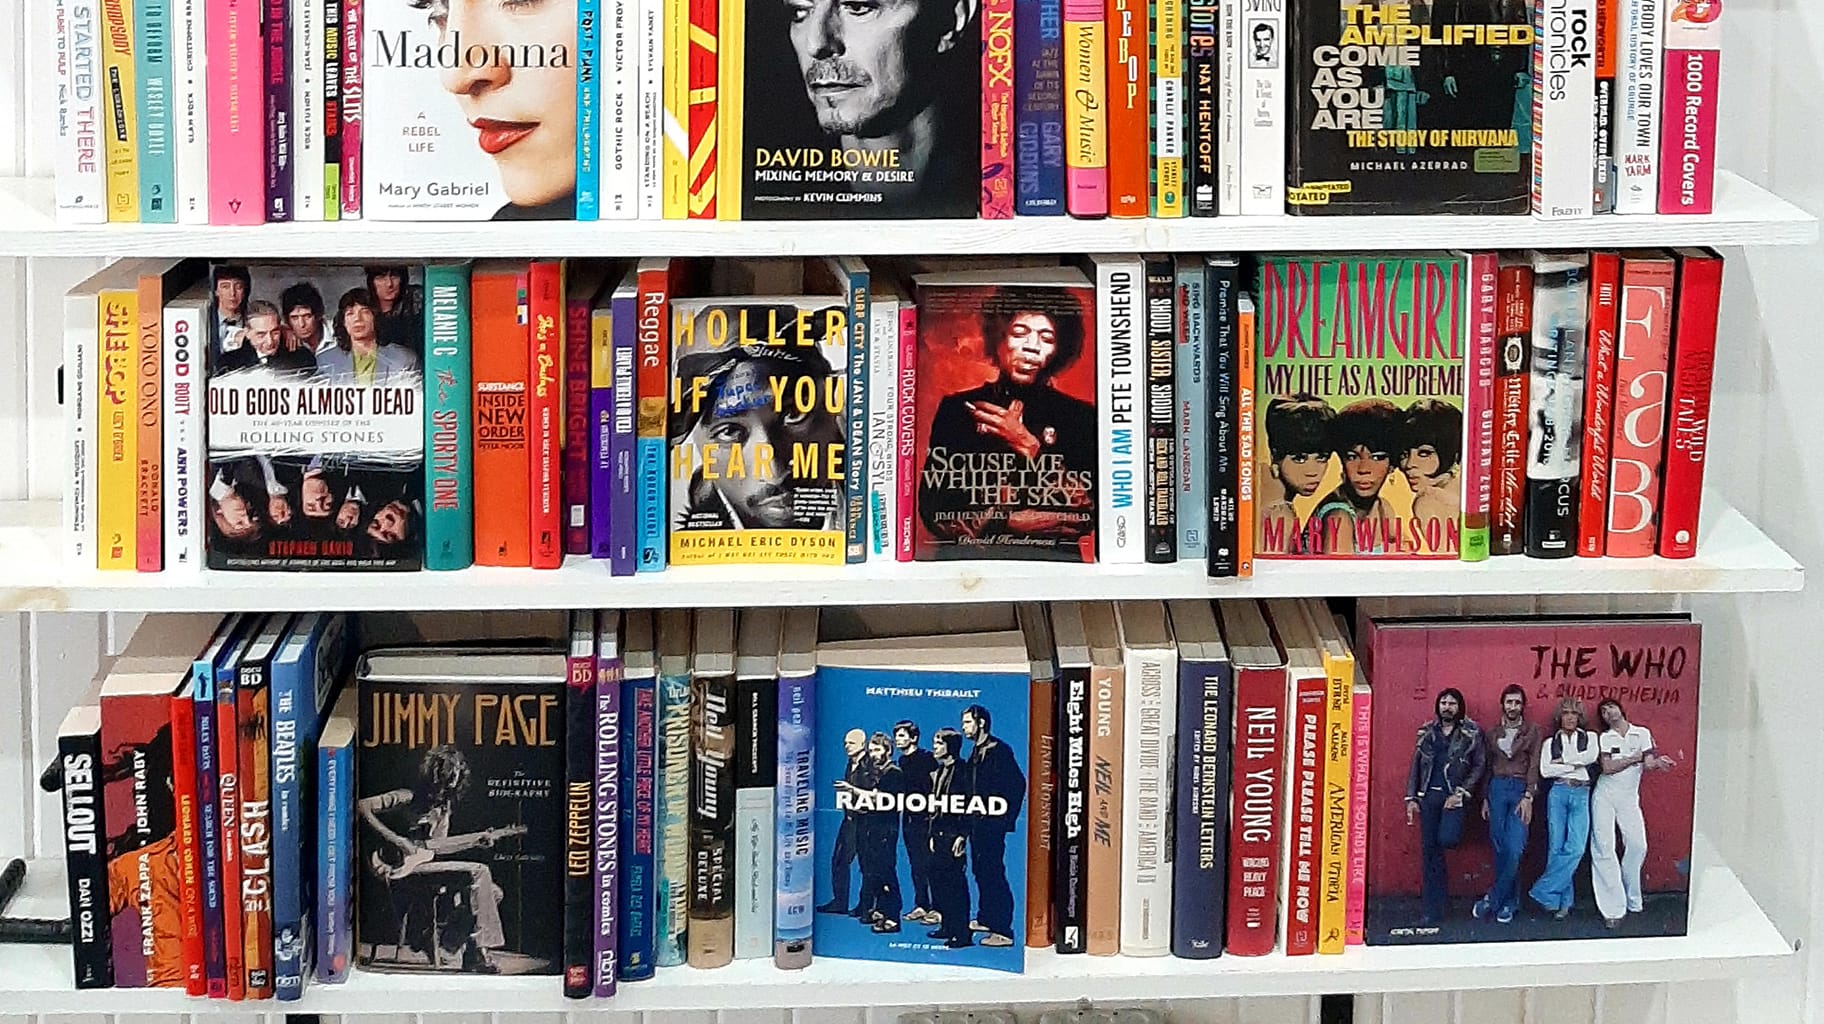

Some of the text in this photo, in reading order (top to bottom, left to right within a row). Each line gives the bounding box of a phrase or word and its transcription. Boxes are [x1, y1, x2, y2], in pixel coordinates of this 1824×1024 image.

[1342, 5, 1411, 24] THE
[371, 30, 572, 68] Madonna
[989, 10, 1012, 88] NOFX
[1340, 25, 1535, 45] AMPLIFIED
[1572, 9, 1590, 68] rock
[1312, 46, 1420, 66] COME
[1640, 44, 1653, 79] LOVES
[1312, 67, 1362, 88] AS
[615, 93, 623, 125] ROCK
[1312, 88, 1384, 108] YOU
[1639, 82, 1650, 106] OUR
[402, 126, 440, 136] REBEL
[1199, 64, 1211, 174] NAT HENTOFF
[1311, 109, 1383, 129] ARE
[1637, 109, 1650, 147] TOWN
[1682, 54, 1703, 206] 1000 Record Covers
[409, 142, 434, 152] LIFE
[615, 128, 623, 170] GOTHIC
[1347, 129, 1518, 147] THE STORY OF NIRVANA
[756, 149, 900, 167] DAVID BOWIE
[1351, 161, 1467, 170] MICHAEL AZERRAD
[1625, 155, 1650, 164] MARK
[1625, 165, 1650, 176] YARM
[379, 182, 488, 198] Mary Gabriel
[756, 171, 802, 181] MIXING
[805, 171, 858, 182] MEMORY
[876, 171, 914, 182] DESIRE
[803, 194, 882, 203] KEVIN CUMMINS
[433, 286, 457, 356] MELANIE C
[1111, 272, 1131, 376] TOWNSHEND
[1263, 262, 1463, 359] DREAMGIRL
[640, 292, 665, 367] Reggae
[674, 310, 847, 346] HOLLER
[1266, 365, 1463, 395] MY LIFE AS A SUPREME
[209, 387, 414, 415] OLD GODS ALMOST DEAD
[478, 395, 524, 407] INSIDE
[674, 376, 844, 415] IF YOU
[1112, 383, 1131, 423] PETE
[478, 409, 525, 424] NEW
[240, 431, 384, 443] ROLLING STONES
[478, 427, 524, 438] ORDER
[1112, 429, 1132, 457] AM
[675, 443, 845, 480] HEAR ME
[177, 447, 188, 537] ANN POWERS
[1112, 470, 1132, 508] WHO
[680, 537, 835, 547] MICHAEL ERIC DYSON
[1263, 517, 1458, 552] MARY WILSON
[1531, 644, 1686, 680] THE WHO
[866, 687, 981, 698] MATTHIEU THIBAULT
[1098, 678, 1112, 737] YOUNG
[276, 689, 296, 783] THE BEATLES
[364, 693, 558, 749] JIMMY PAGE
[1243, 707, 1276, 843] NEIL YOUNG
[835, 791, 1008, 815] RADIOHEAD
[135, 750, 153, 955] FRANK ZAPPA JOHN RABY
